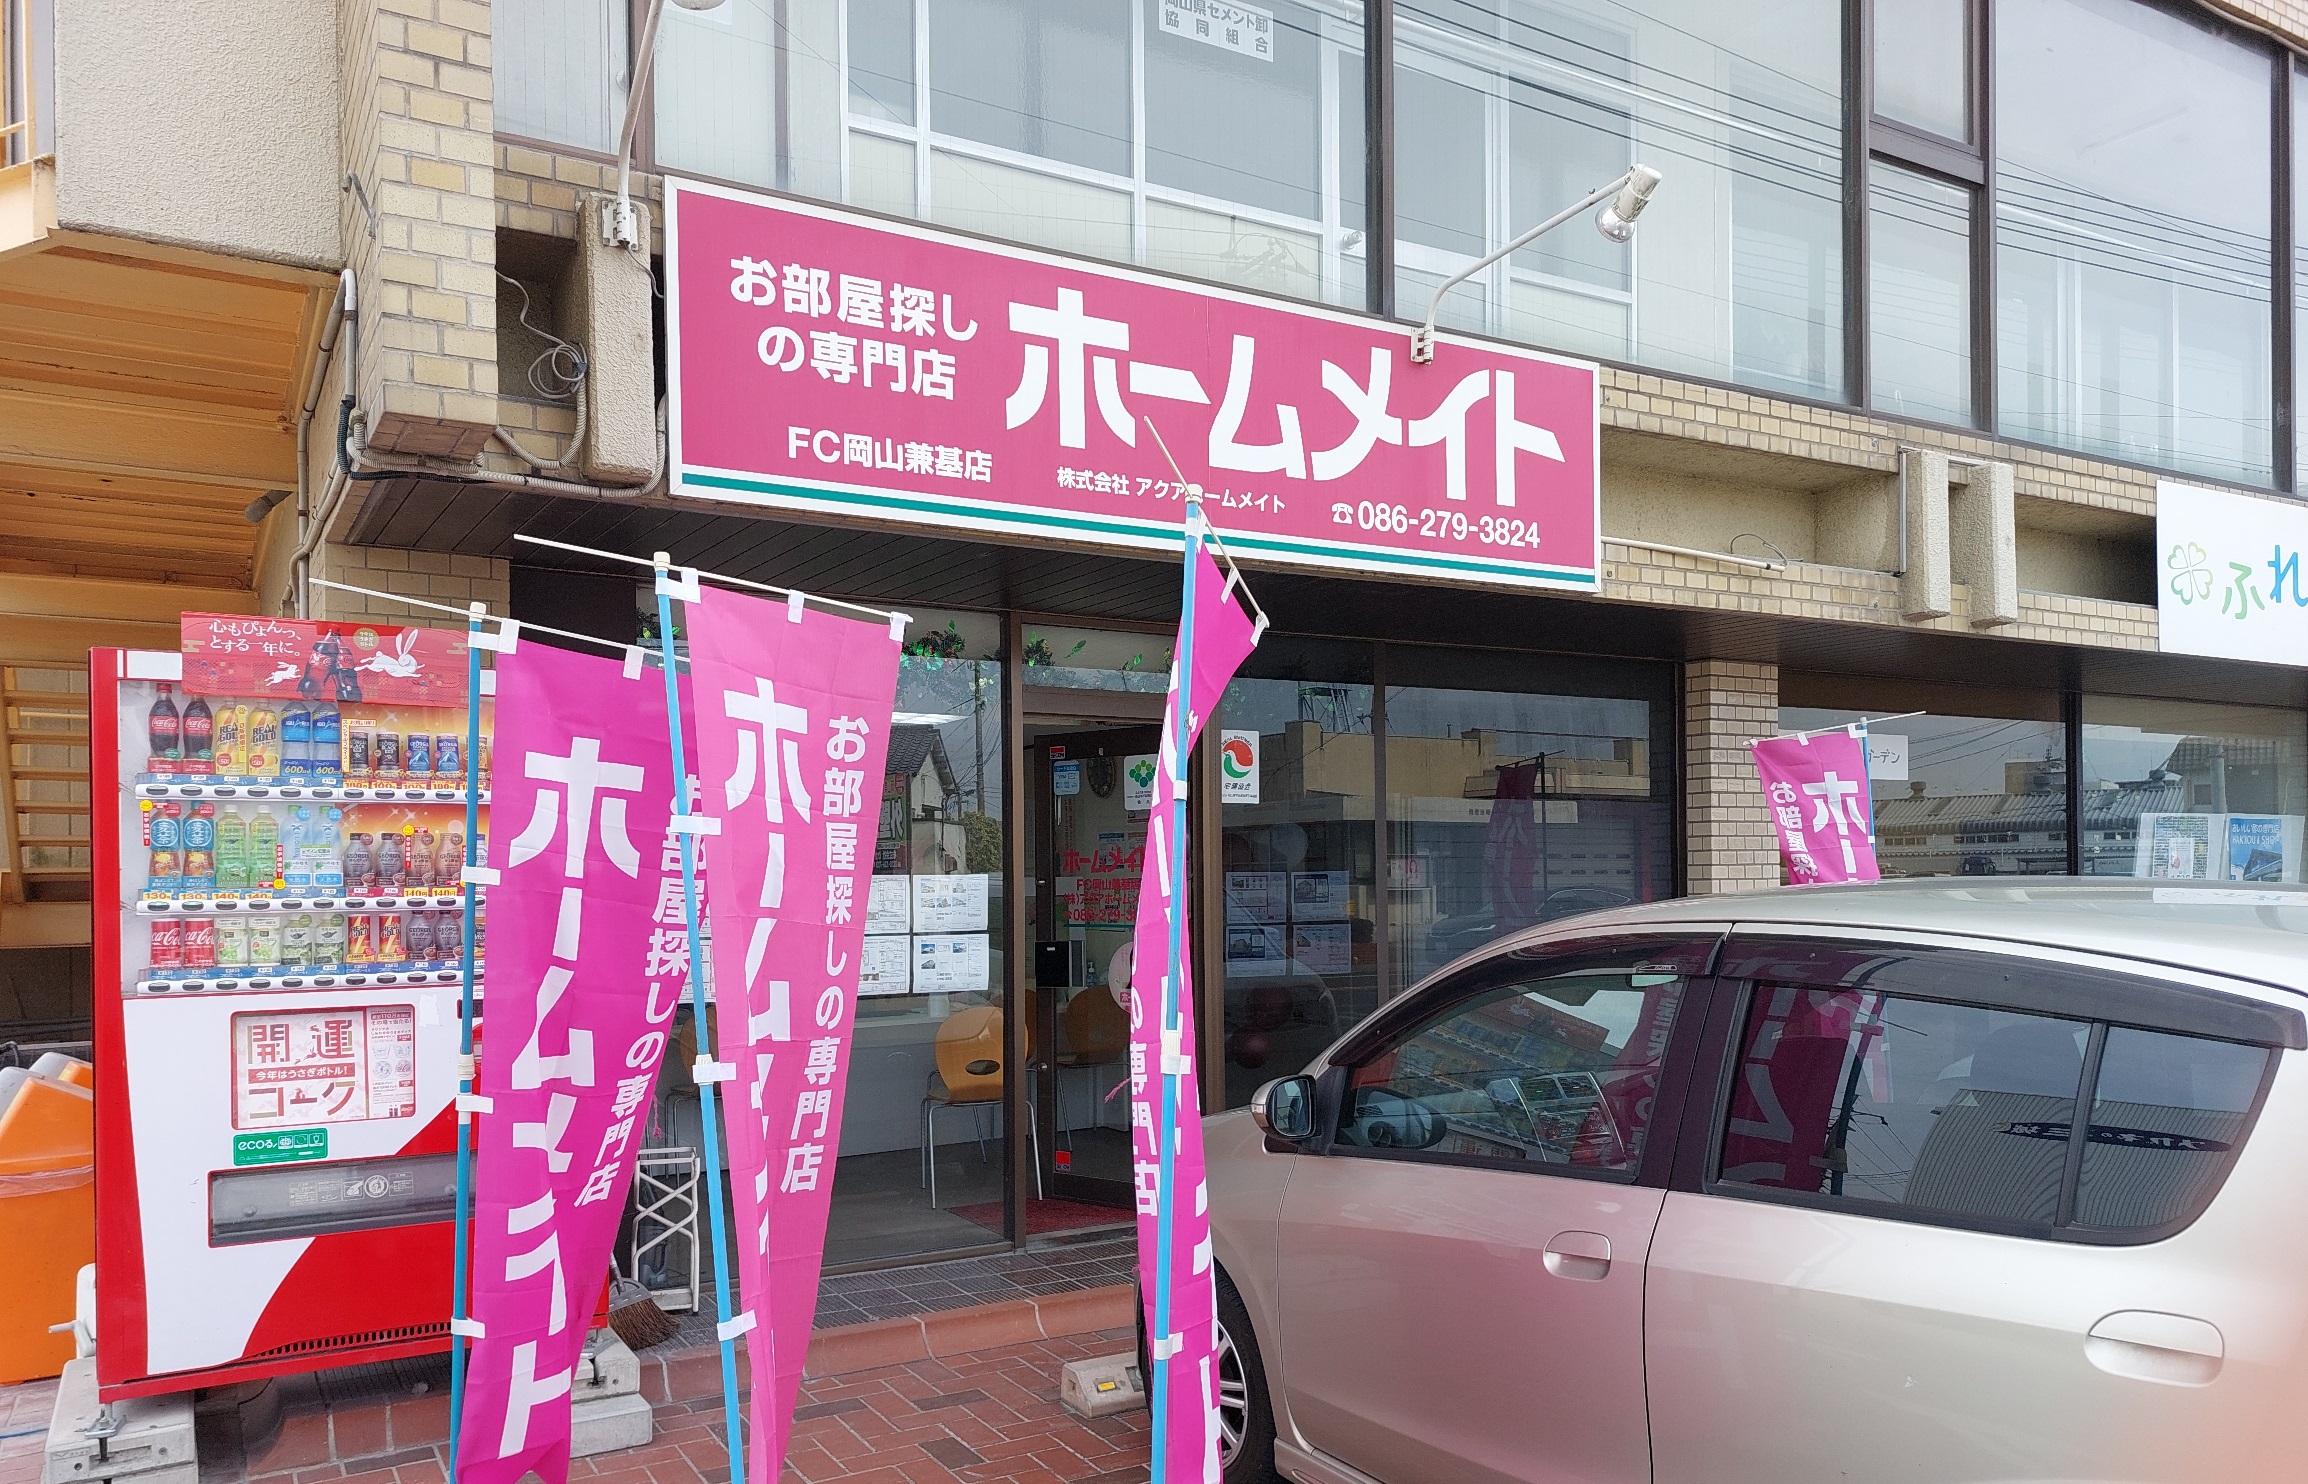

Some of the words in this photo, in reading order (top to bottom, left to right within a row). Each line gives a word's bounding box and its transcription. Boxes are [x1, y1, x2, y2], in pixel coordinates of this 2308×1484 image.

[730, 254, 978, 342] お部屋探し
[757, 327, 957, 402] の専門店
[1006, 287, 1566, 507] ホームメイト
[786, 424, 994, 484] FC岡山兼基店
[1057, 466, 1130, 496] 株式会社
[1136, 477, 1286, 514] アクアームメイト
[1357, 500, 1541, 549] 086-279-3824
[780, 714, 872, 1194] お部屋探しの専門店
[247, 1019, 355, 1064] 開運
[256, 1067, 348, 1081] 今年はうさぎボトル!
